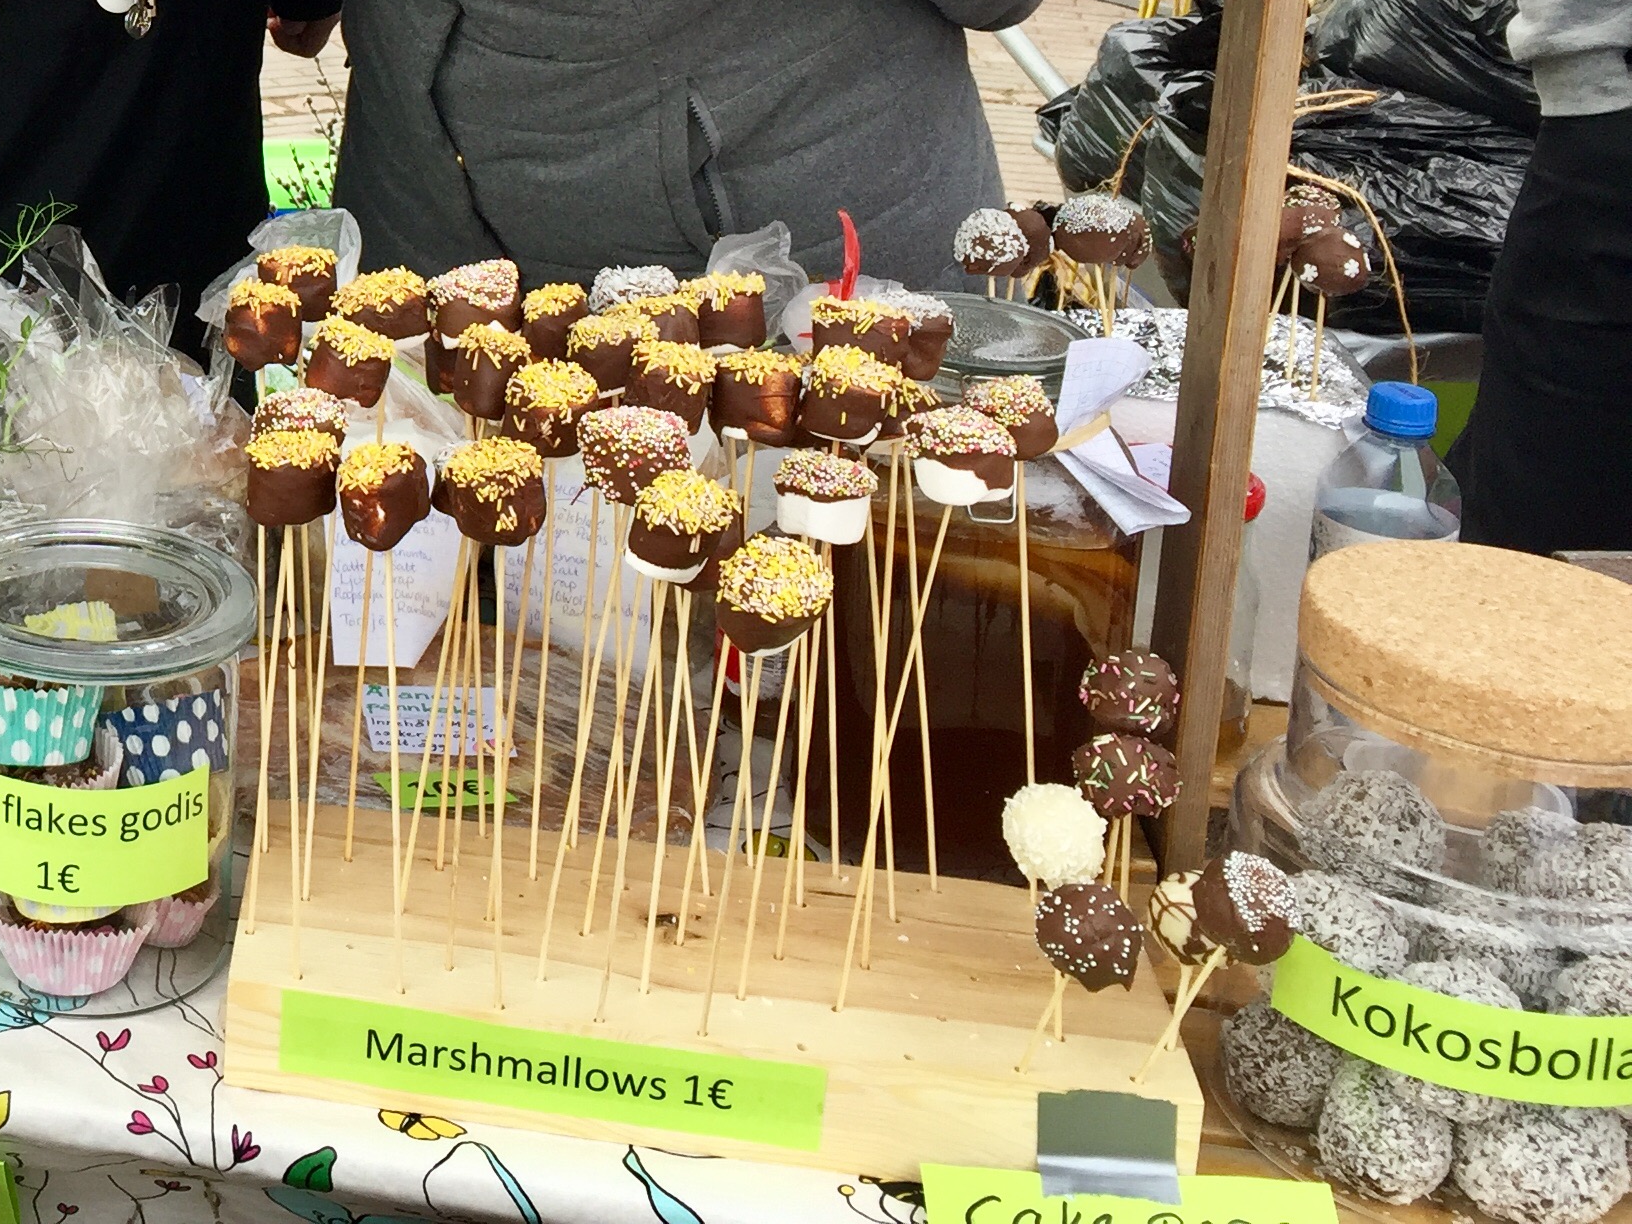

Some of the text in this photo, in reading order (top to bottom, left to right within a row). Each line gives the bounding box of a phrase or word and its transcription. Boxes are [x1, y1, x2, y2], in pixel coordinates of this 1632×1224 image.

[1, 793, 108, 837] flakes
[119, 790, 204, 843] godis
[36, 860, 81, 894] 1€
[366, 1028, 735, 1111] Marshmallows 1€
